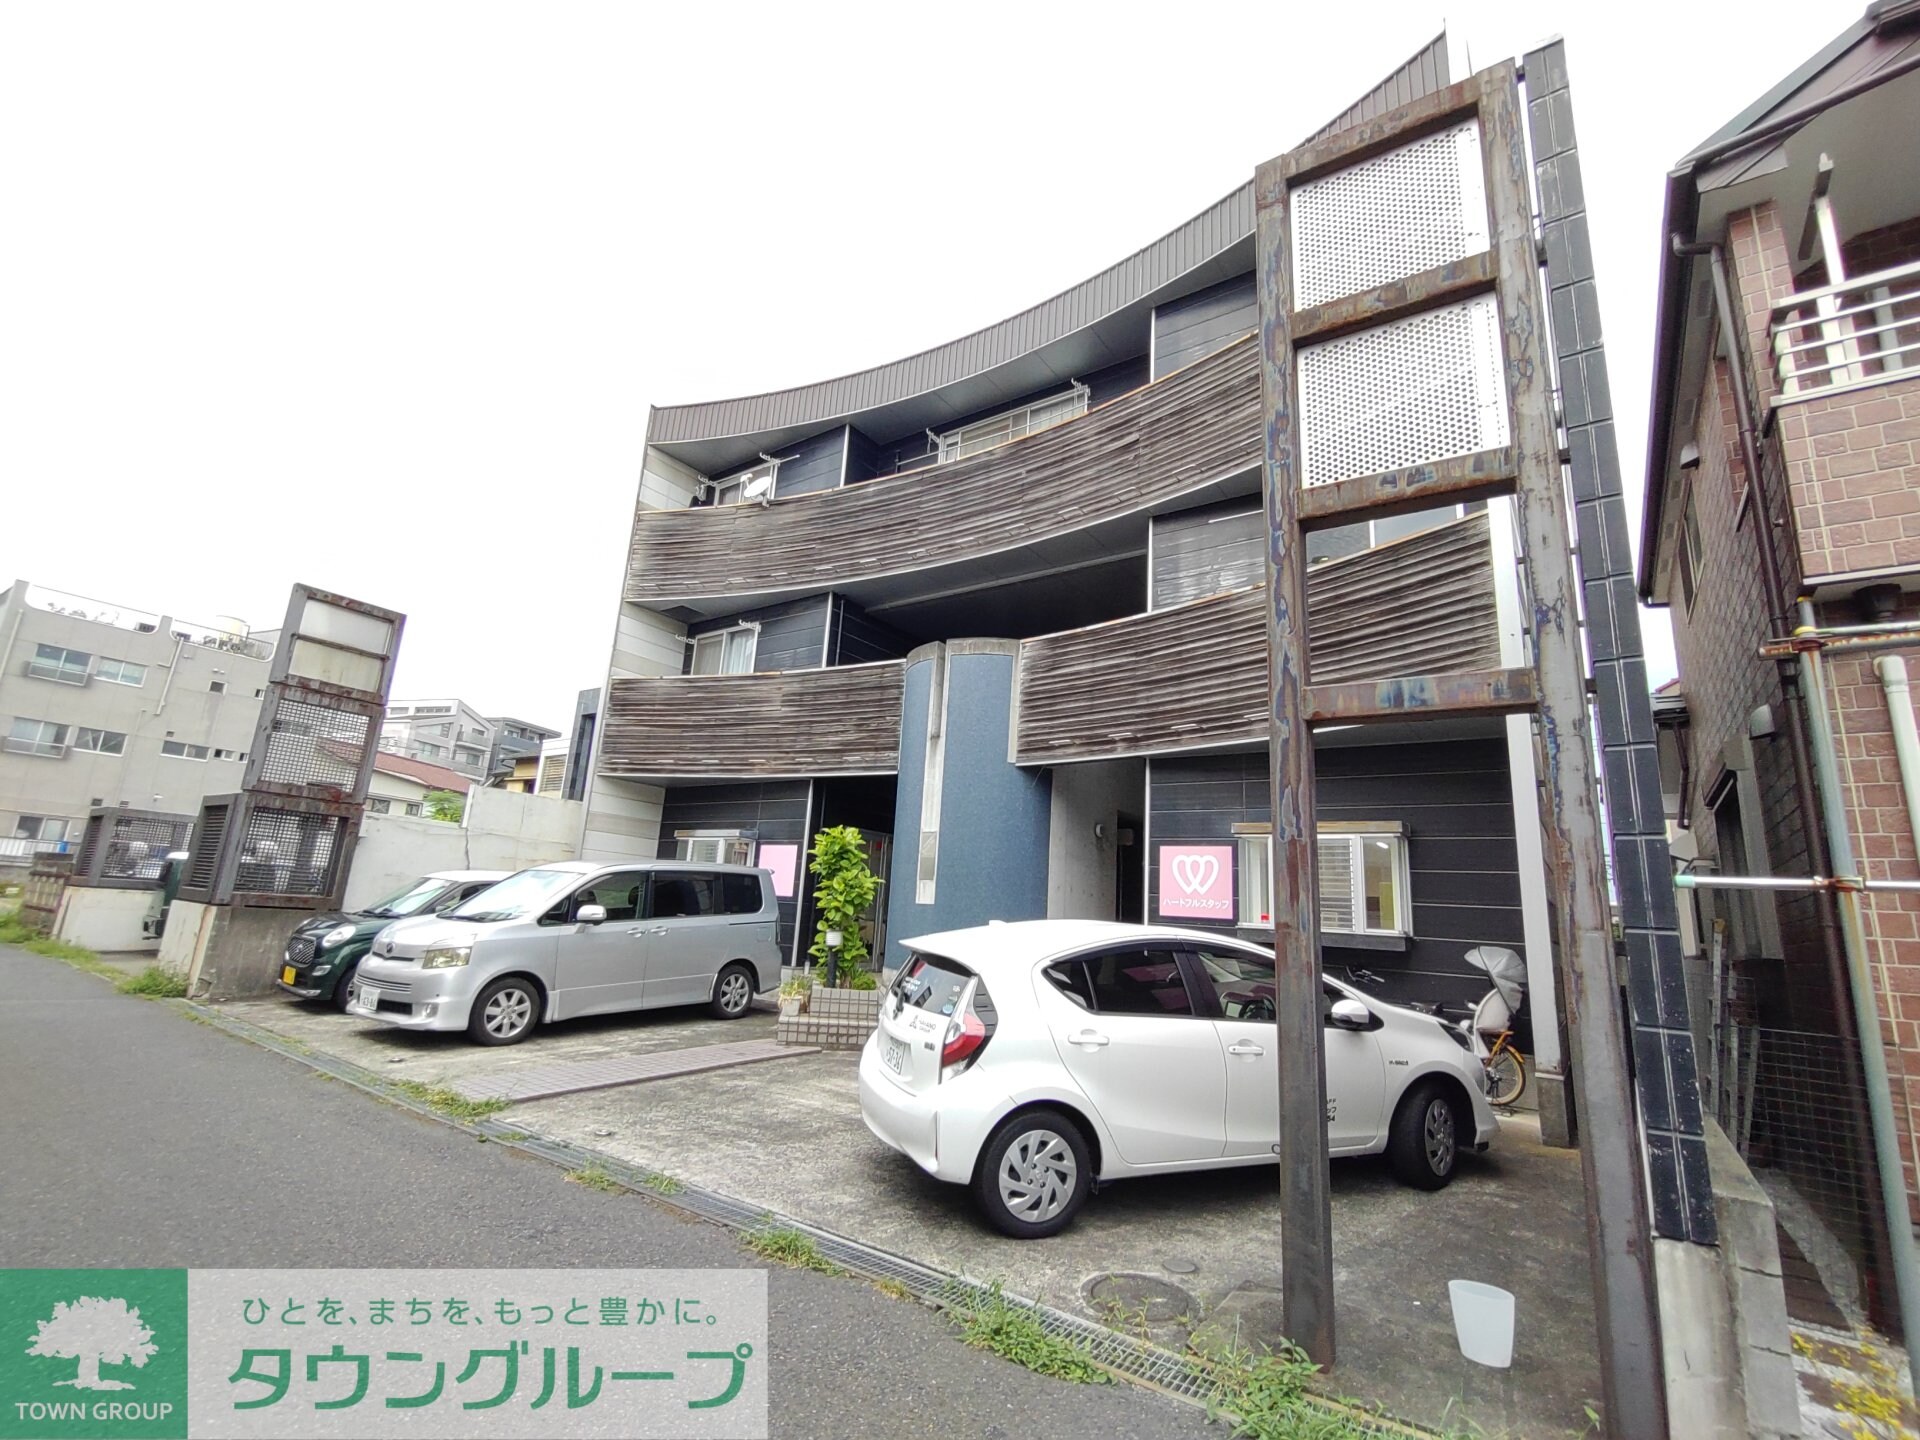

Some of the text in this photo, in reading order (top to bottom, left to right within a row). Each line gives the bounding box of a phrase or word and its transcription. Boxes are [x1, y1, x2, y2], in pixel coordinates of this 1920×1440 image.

[1163, 898, 1229, 909] ハートフルスタッフ
